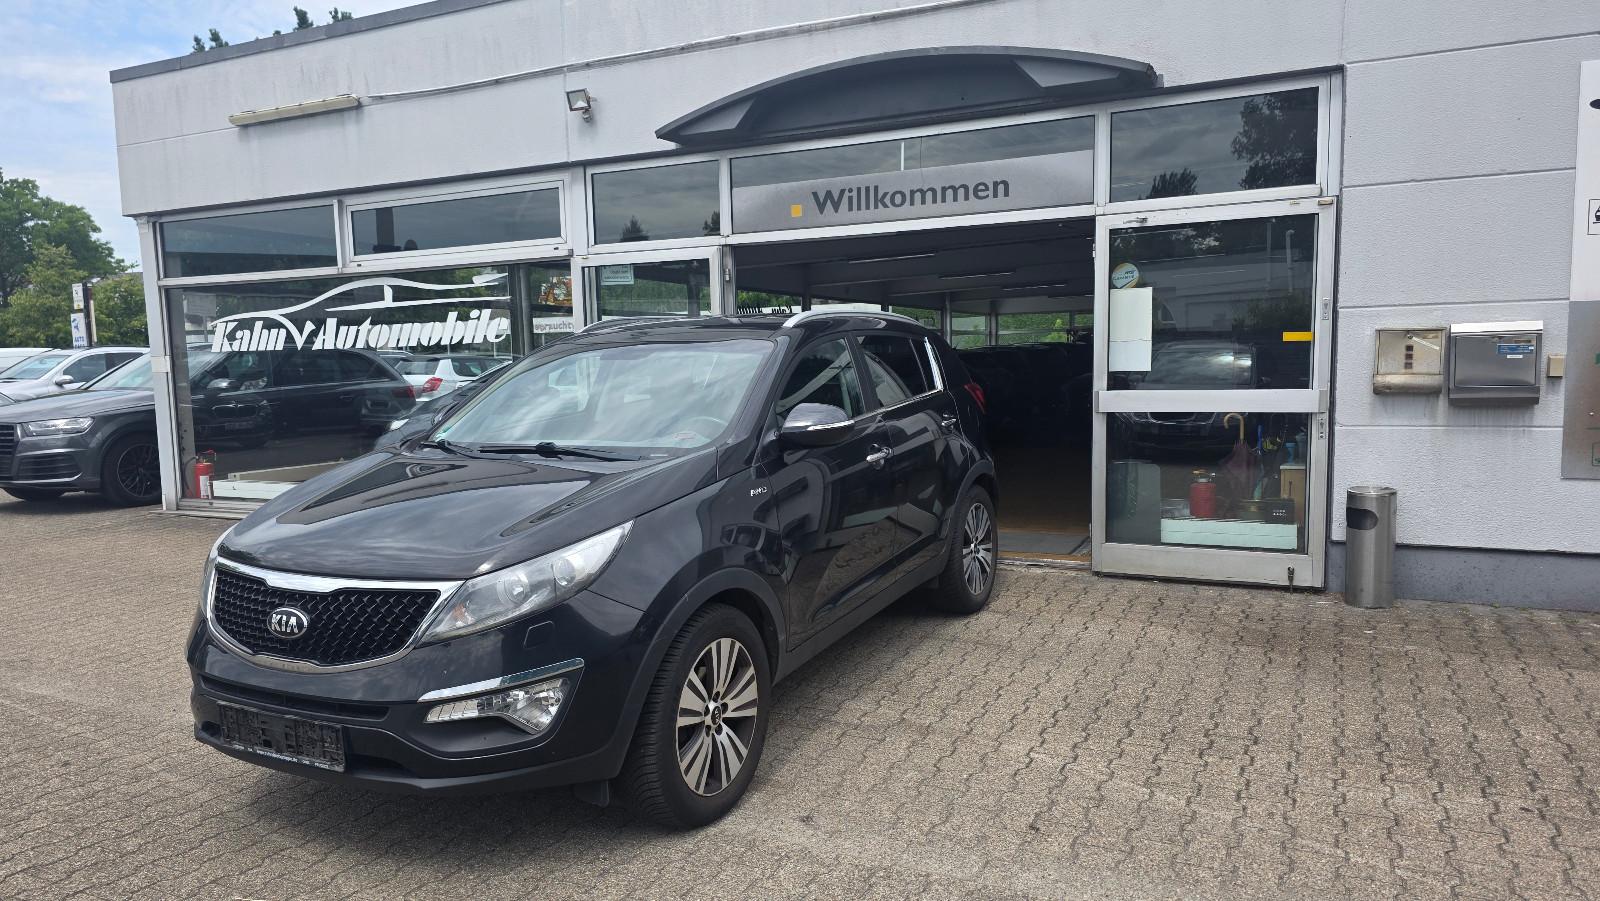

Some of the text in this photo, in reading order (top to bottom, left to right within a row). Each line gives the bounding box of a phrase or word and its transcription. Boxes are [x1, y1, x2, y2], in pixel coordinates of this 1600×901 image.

[811, 178, 1010, 216] Willkommen
[210, 309, 508, 352] Kahn Automobile
[271, 613, 299, 633] KIA
